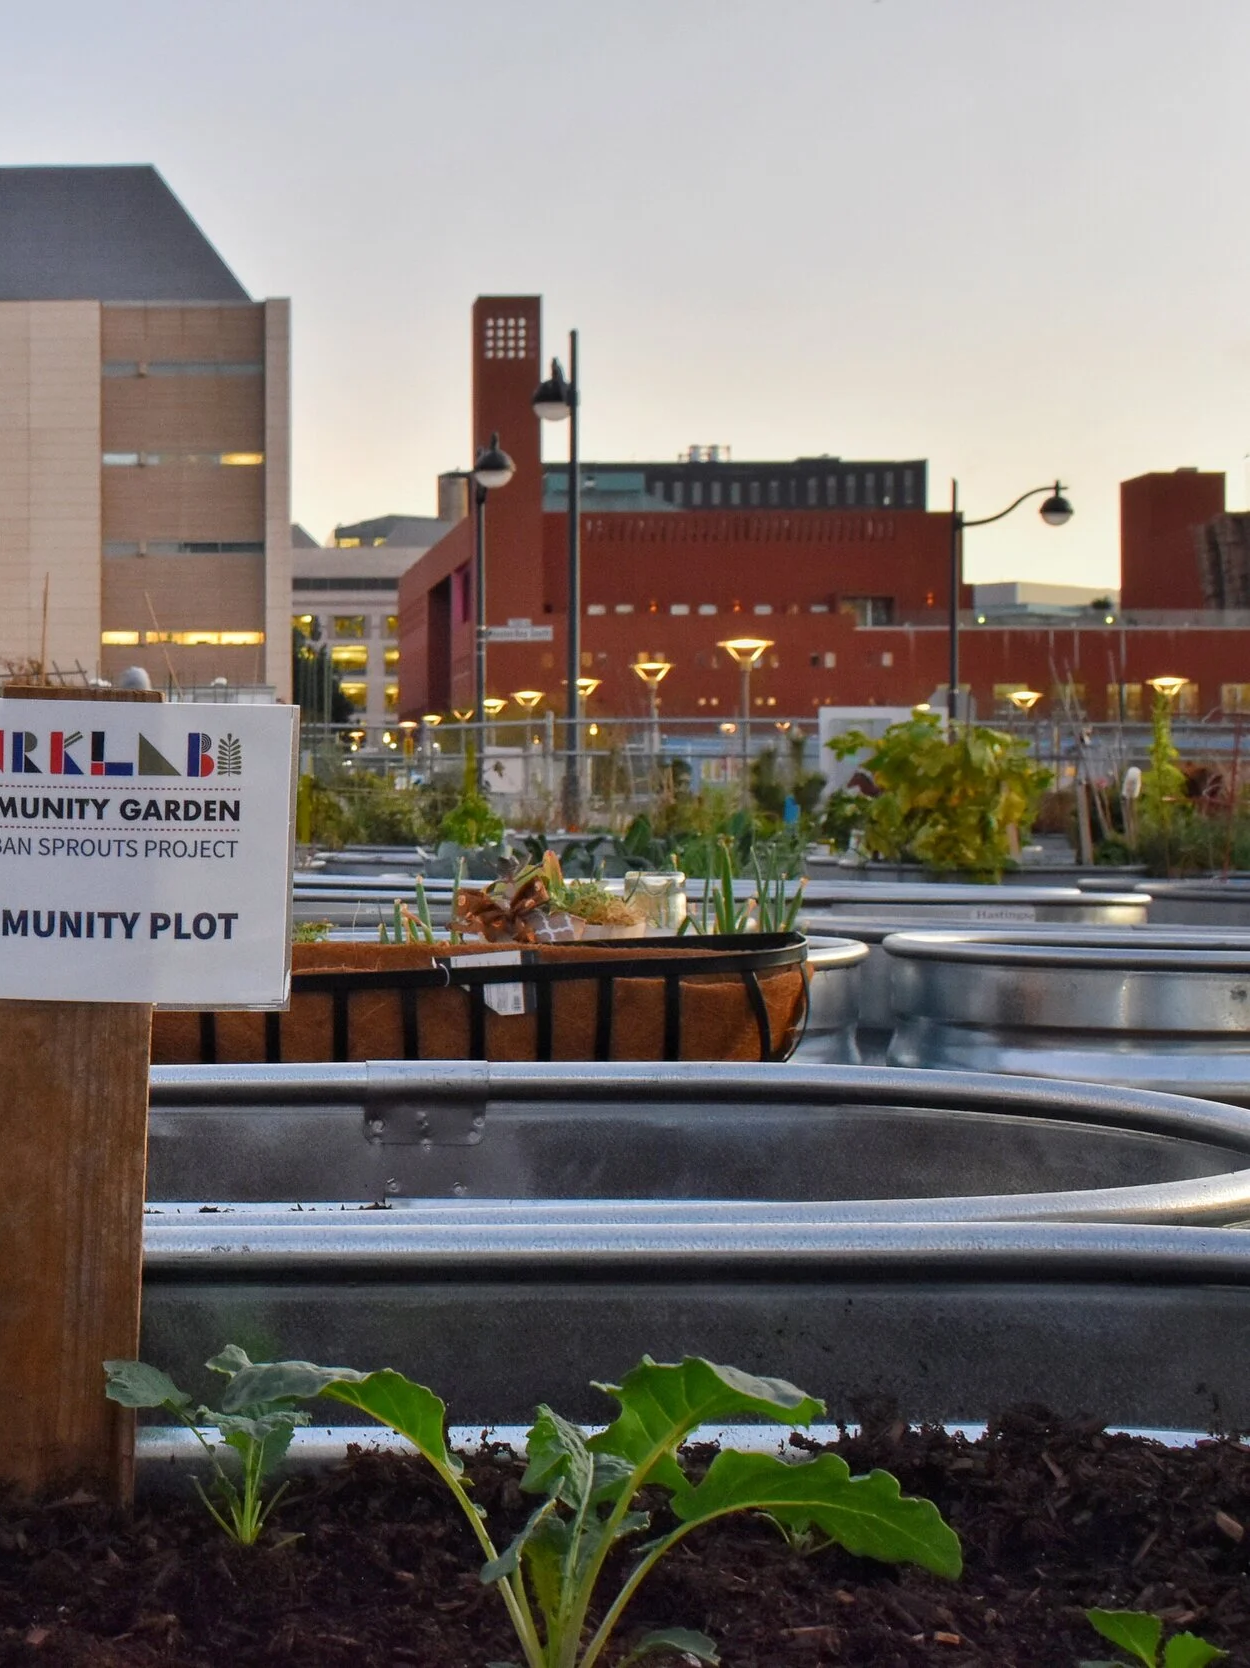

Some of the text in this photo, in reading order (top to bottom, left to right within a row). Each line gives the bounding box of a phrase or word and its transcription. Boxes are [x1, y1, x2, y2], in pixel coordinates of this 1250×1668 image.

[119, 799, 240, 821] GARDEN
[38, 838, 138, 857] SPROUTS
[145, 840, 238, 858] PROJECT
[150, 913, 238, 940] PLOT
